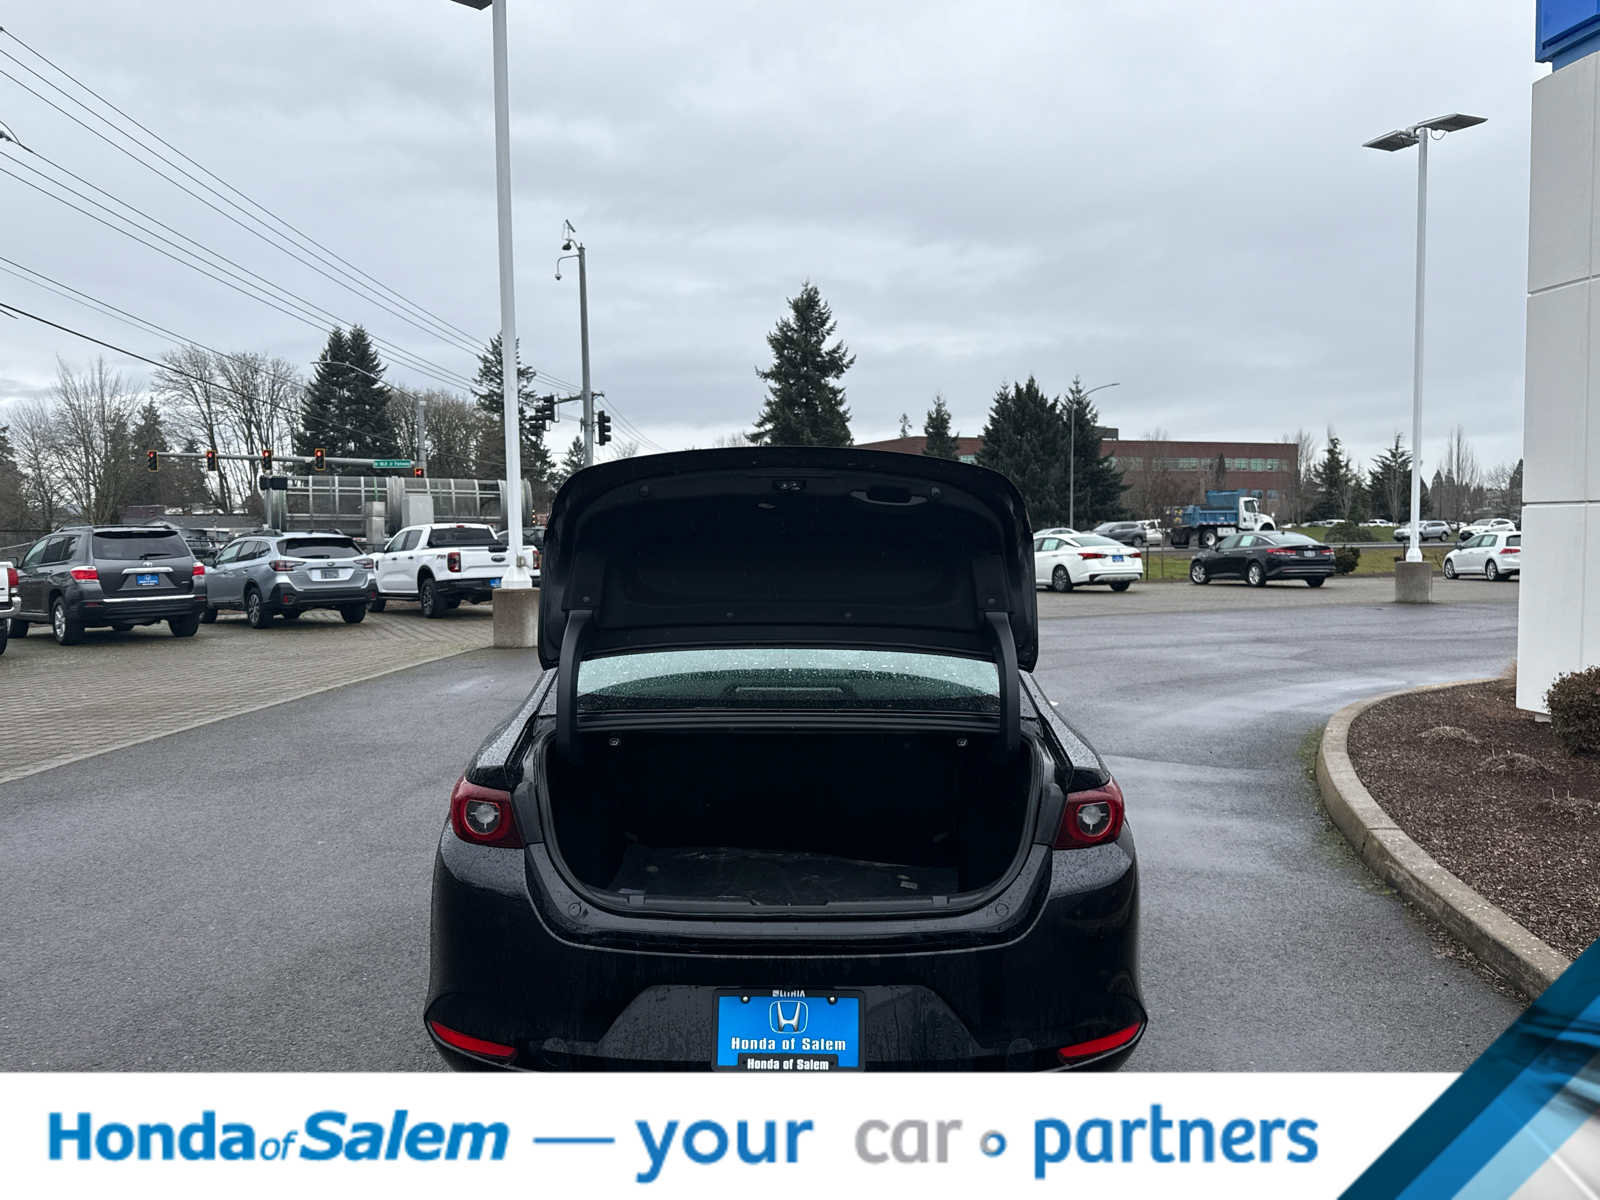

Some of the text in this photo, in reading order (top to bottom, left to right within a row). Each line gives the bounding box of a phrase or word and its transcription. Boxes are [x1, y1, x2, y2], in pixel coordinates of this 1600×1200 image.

[731, 1037, 846, 1051] Honda of Salem
[747, 1058, 829, 1070] Honda of Salem
